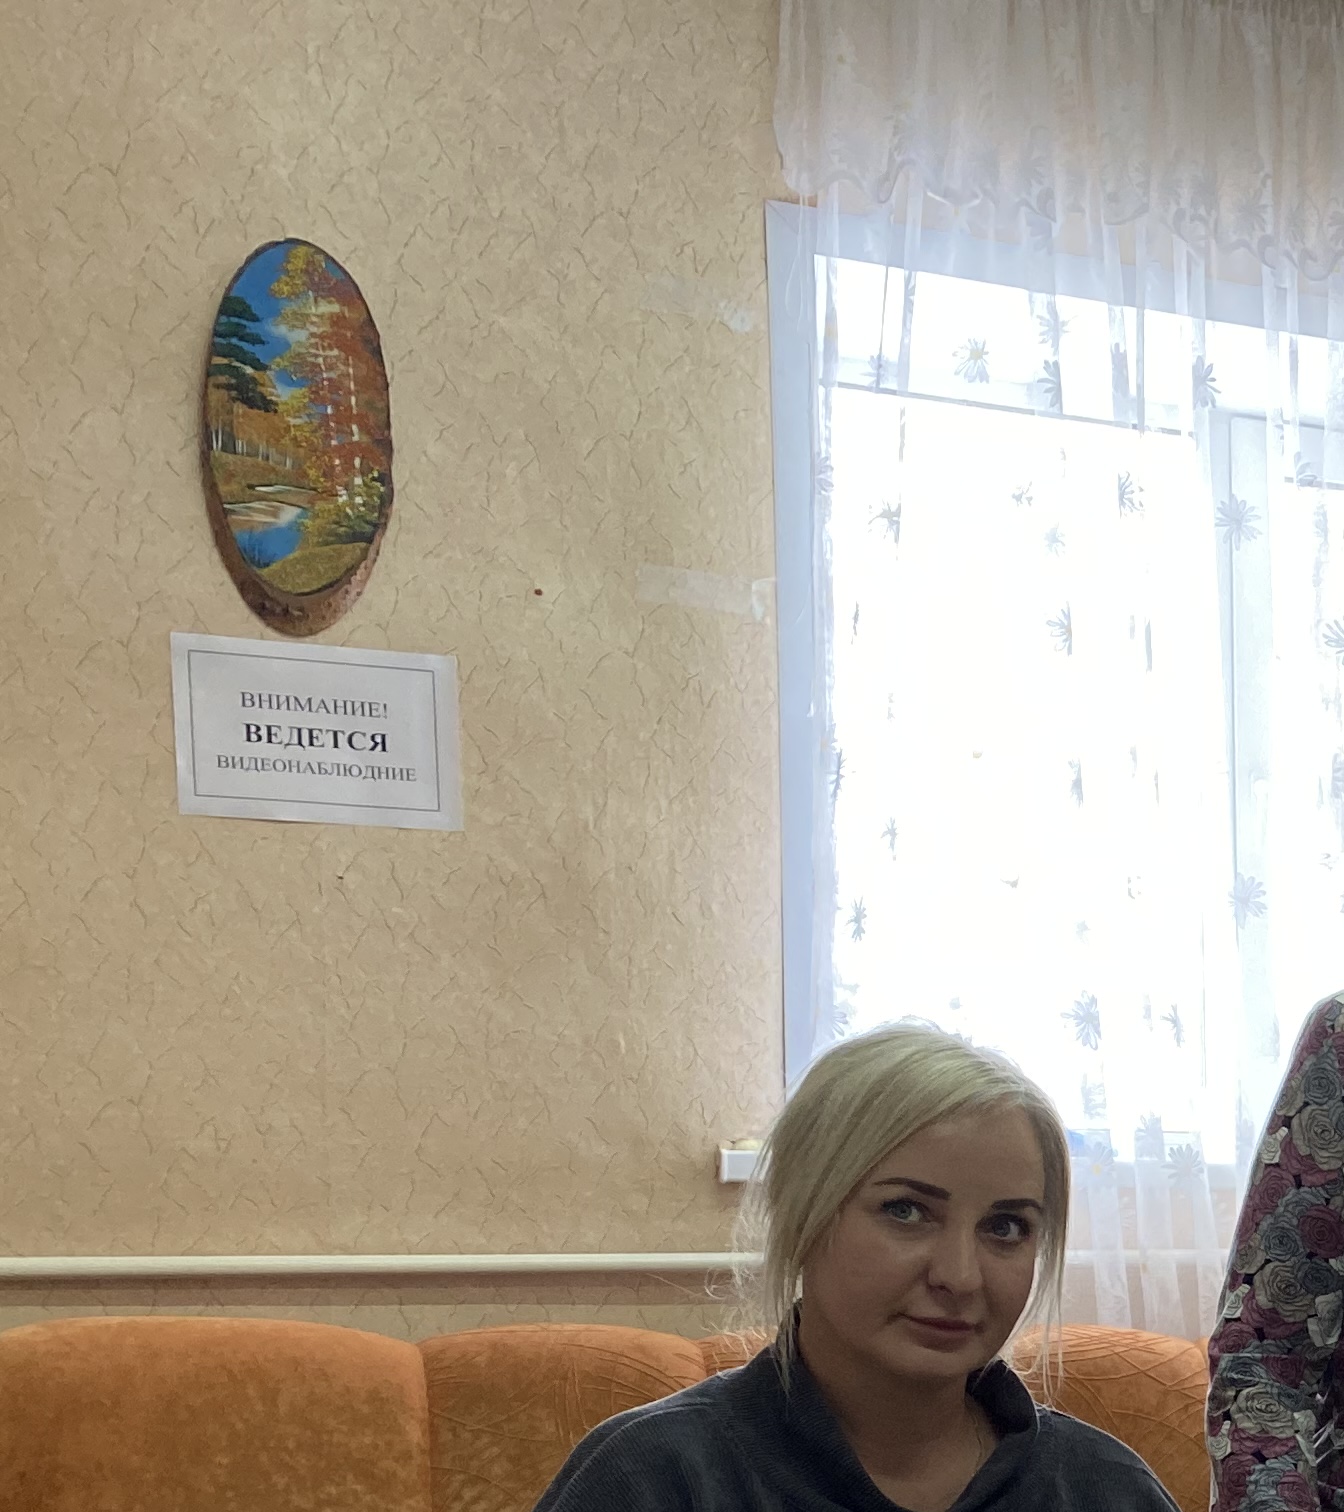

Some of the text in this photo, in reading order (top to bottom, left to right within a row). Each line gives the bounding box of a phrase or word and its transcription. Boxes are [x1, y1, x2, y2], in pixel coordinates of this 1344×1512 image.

[240, 691, 387, 719] ВНИМАНИЕ!
[242, 722, 388, 752] ВЕДЕТСЯ
[216, 754, 417, 782] ВИДЕОНАБЛЮДНИЕ
